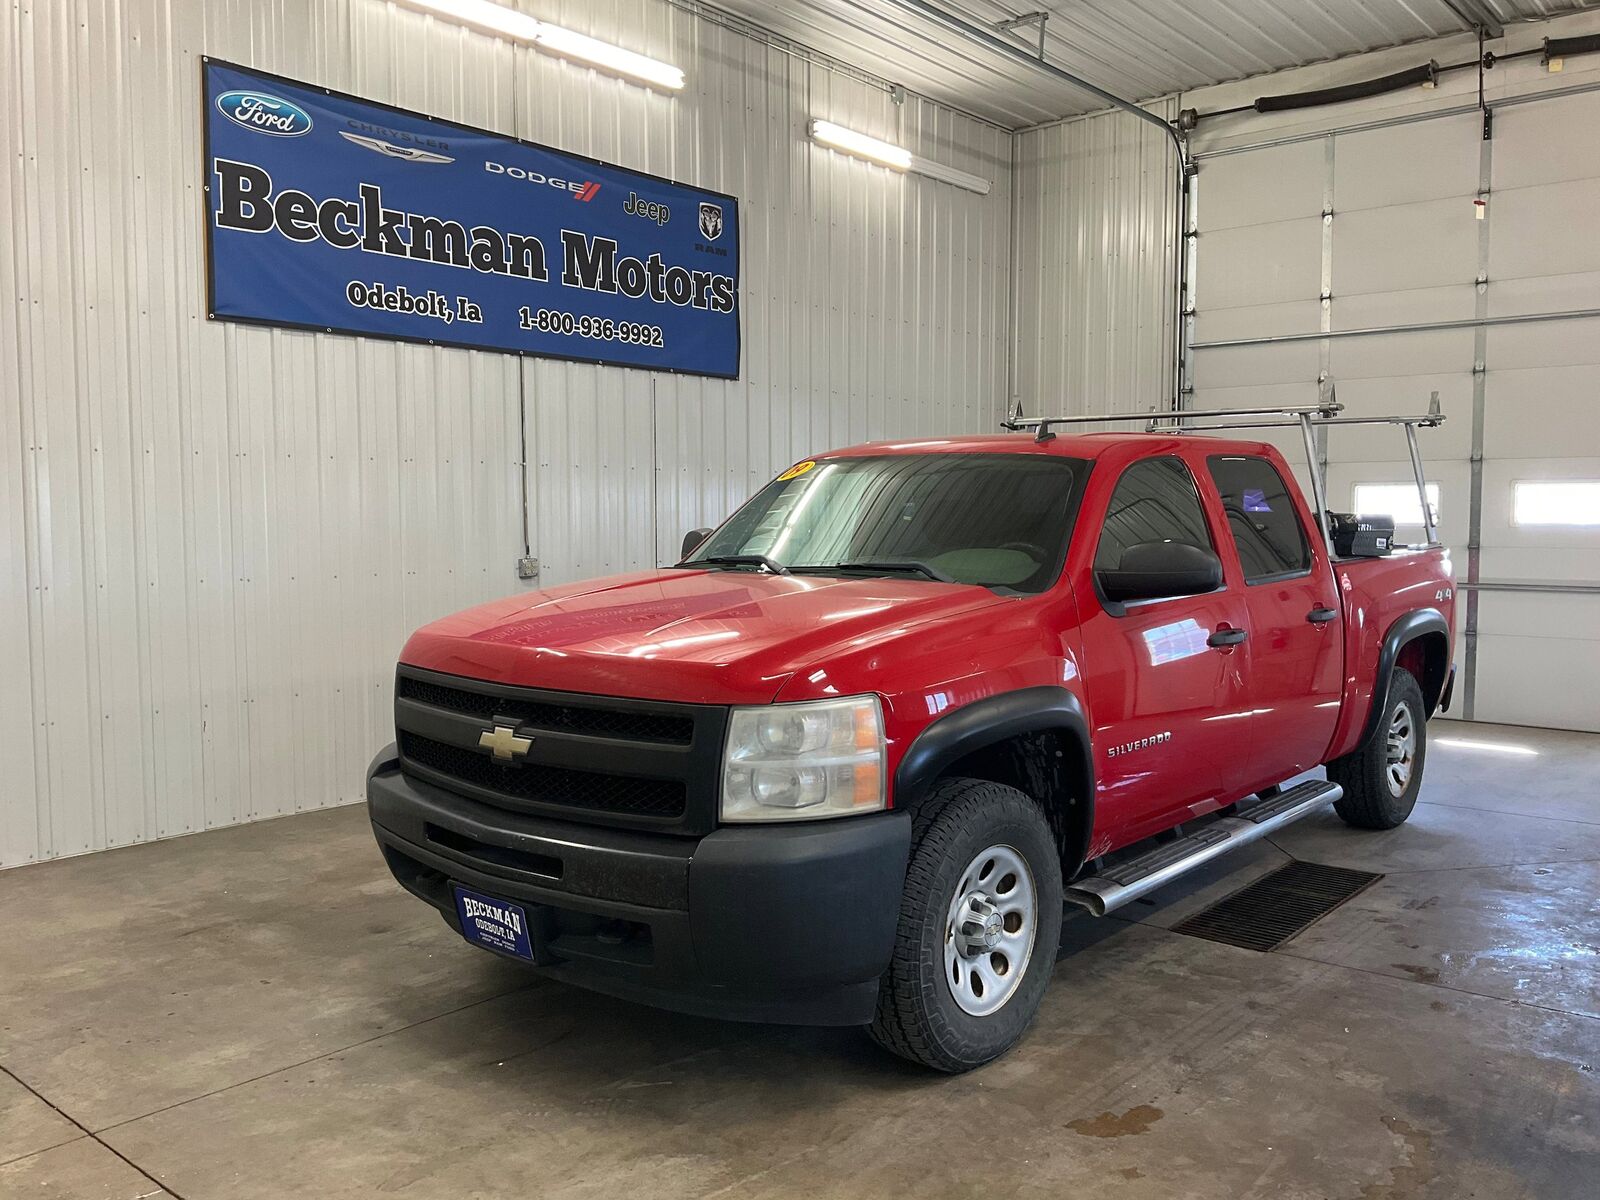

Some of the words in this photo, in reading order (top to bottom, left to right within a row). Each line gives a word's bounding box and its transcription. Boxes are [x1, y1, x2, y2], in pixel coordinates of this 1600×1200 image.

[234, 96, 294, 132] Ford
[346, 120, 449, 150] CHRYSLER
[485, 161, 585, 194] DODGE
[623, 192, 670, 226] Jeep
[214, 157, 548, 282] Beckman
[561, 229, 734, 313] Motors
[695, 243, 728, 257] RAM
[346, 280, 455, 325] Odebolt,
[457, 296, 483, 324] Ia
[519, 306, 664, 348] 1-800-936-9992
[1108, 731, 1171, 757] SILVERADO
[463, 896, 521, 935] BECKMAN
